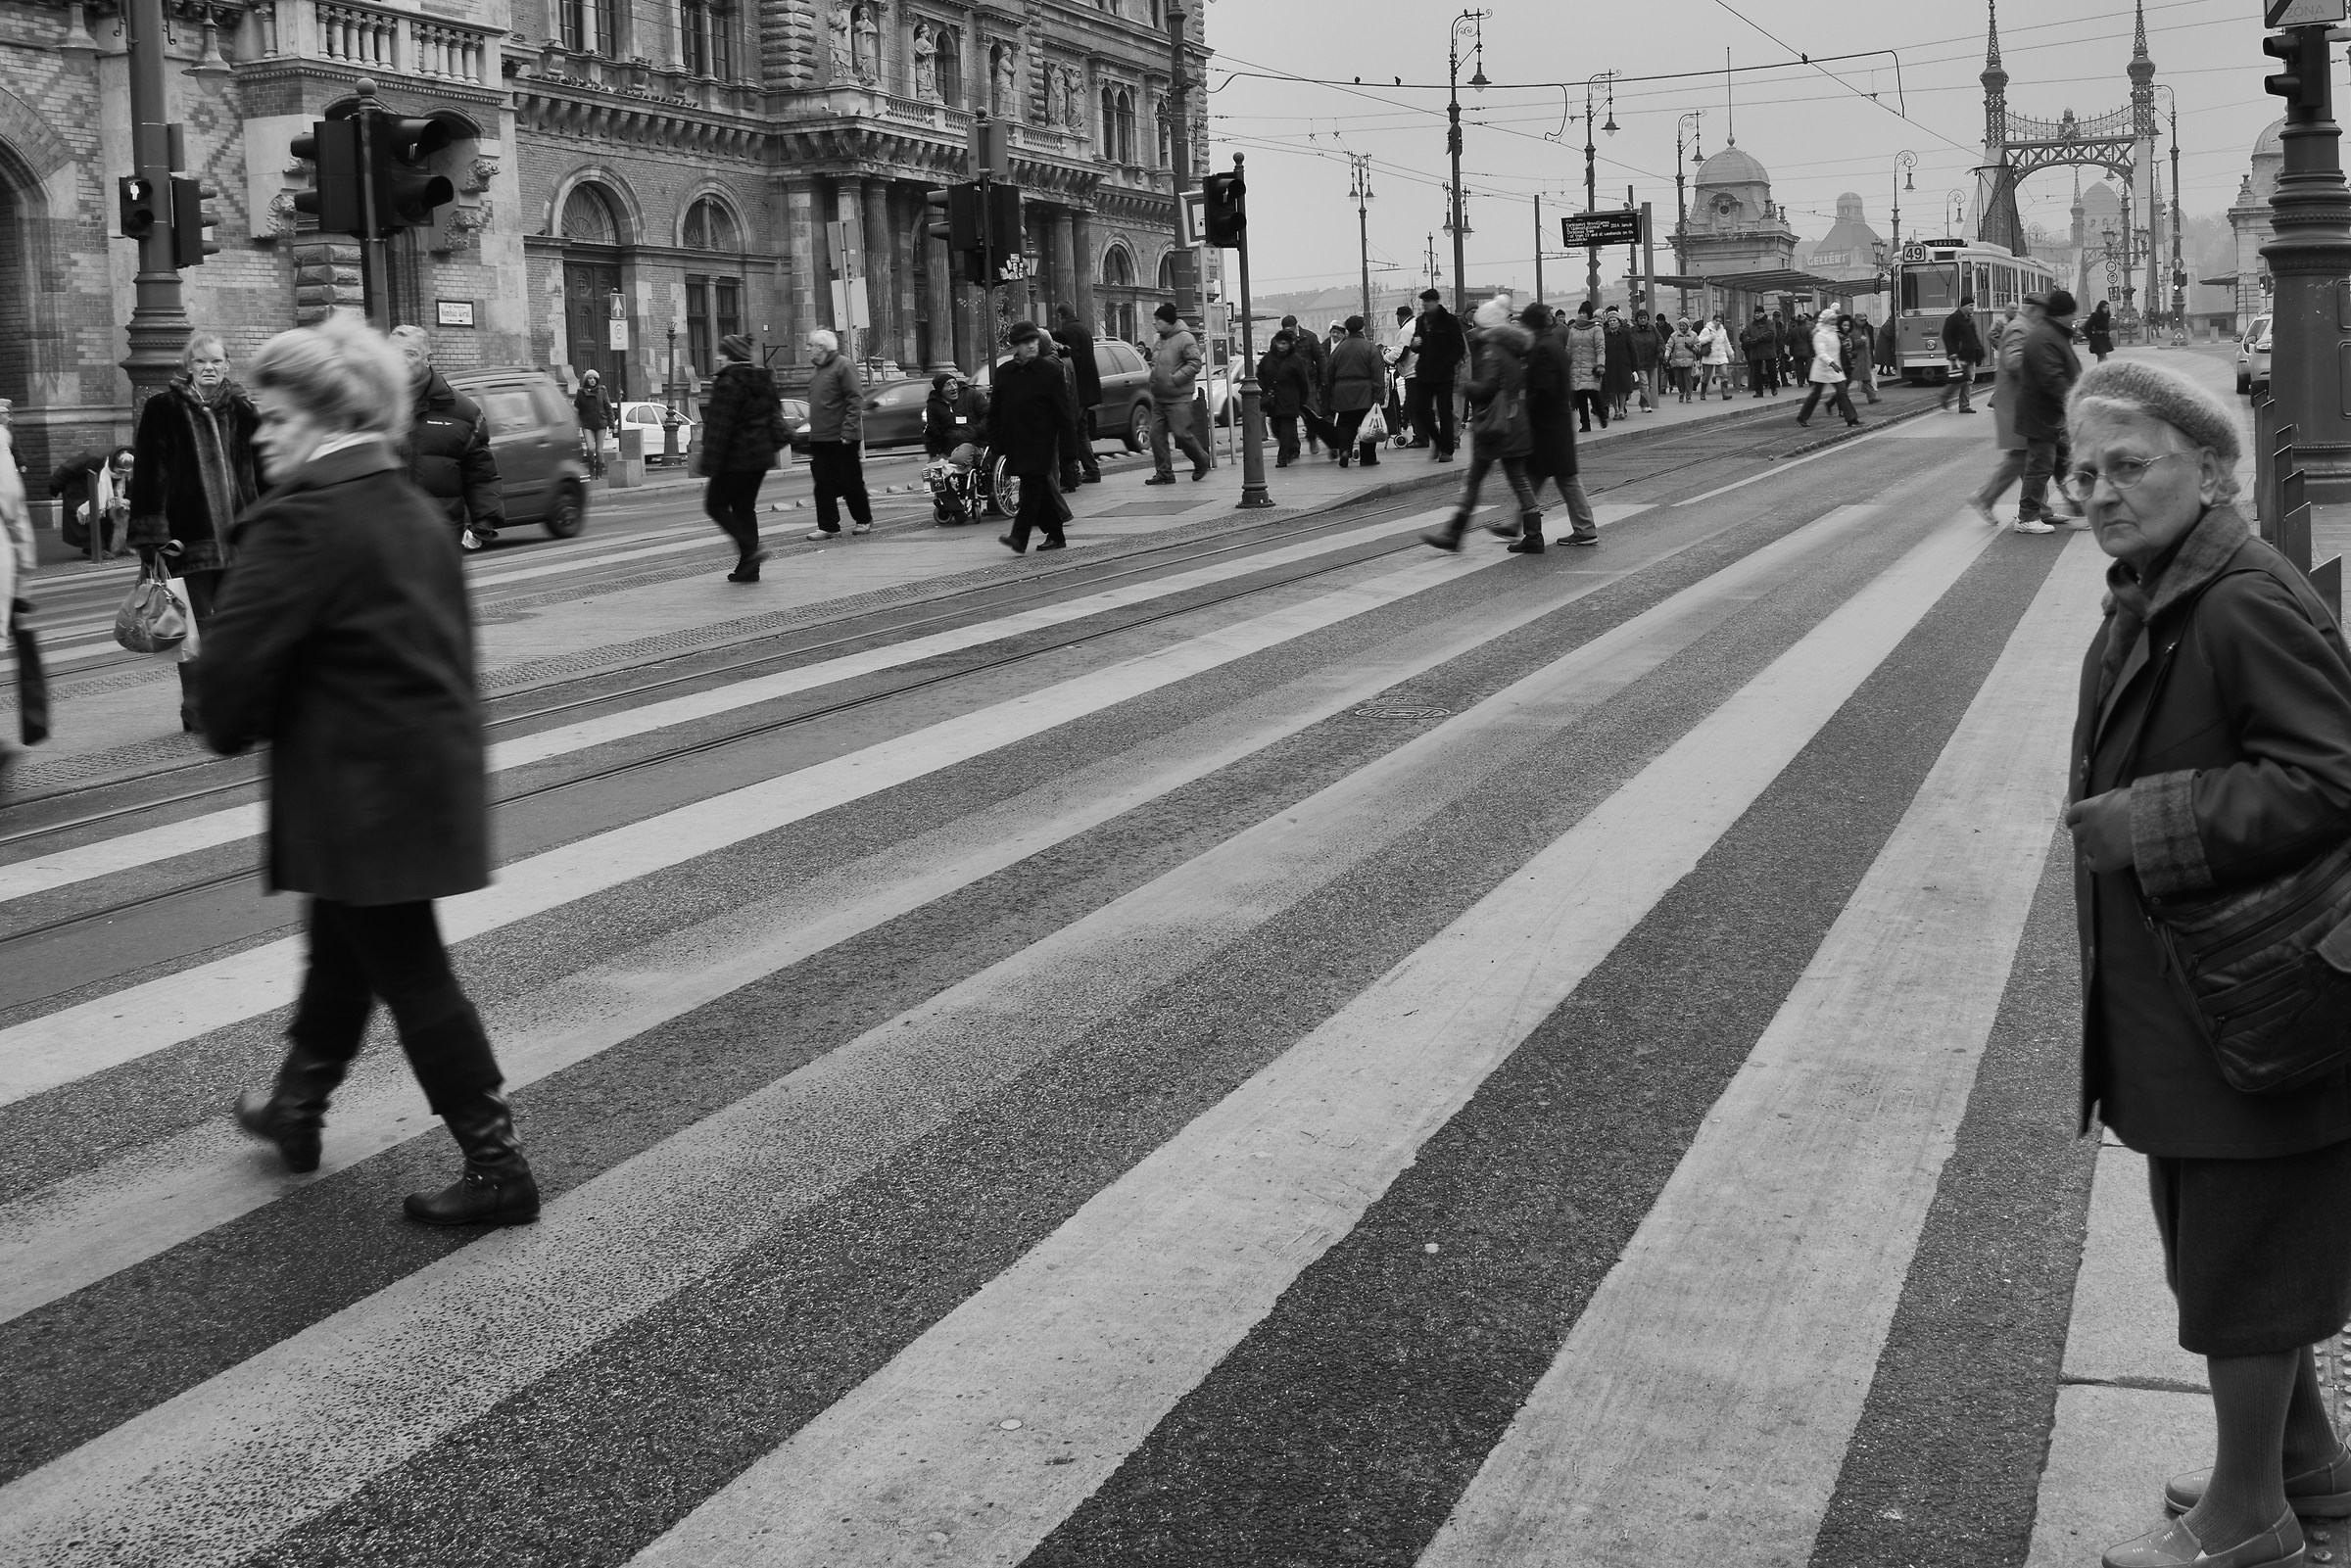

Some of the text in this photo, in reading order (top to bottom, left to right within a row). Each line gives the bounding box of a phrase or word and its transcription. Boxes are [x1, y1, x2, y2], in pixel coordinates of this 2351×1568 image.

[2285, 3, 2325, 18] ZÓNA
[1807, 252, 1848, 266] GELLÉRT
[1905, 247, 1923, 261] 49
